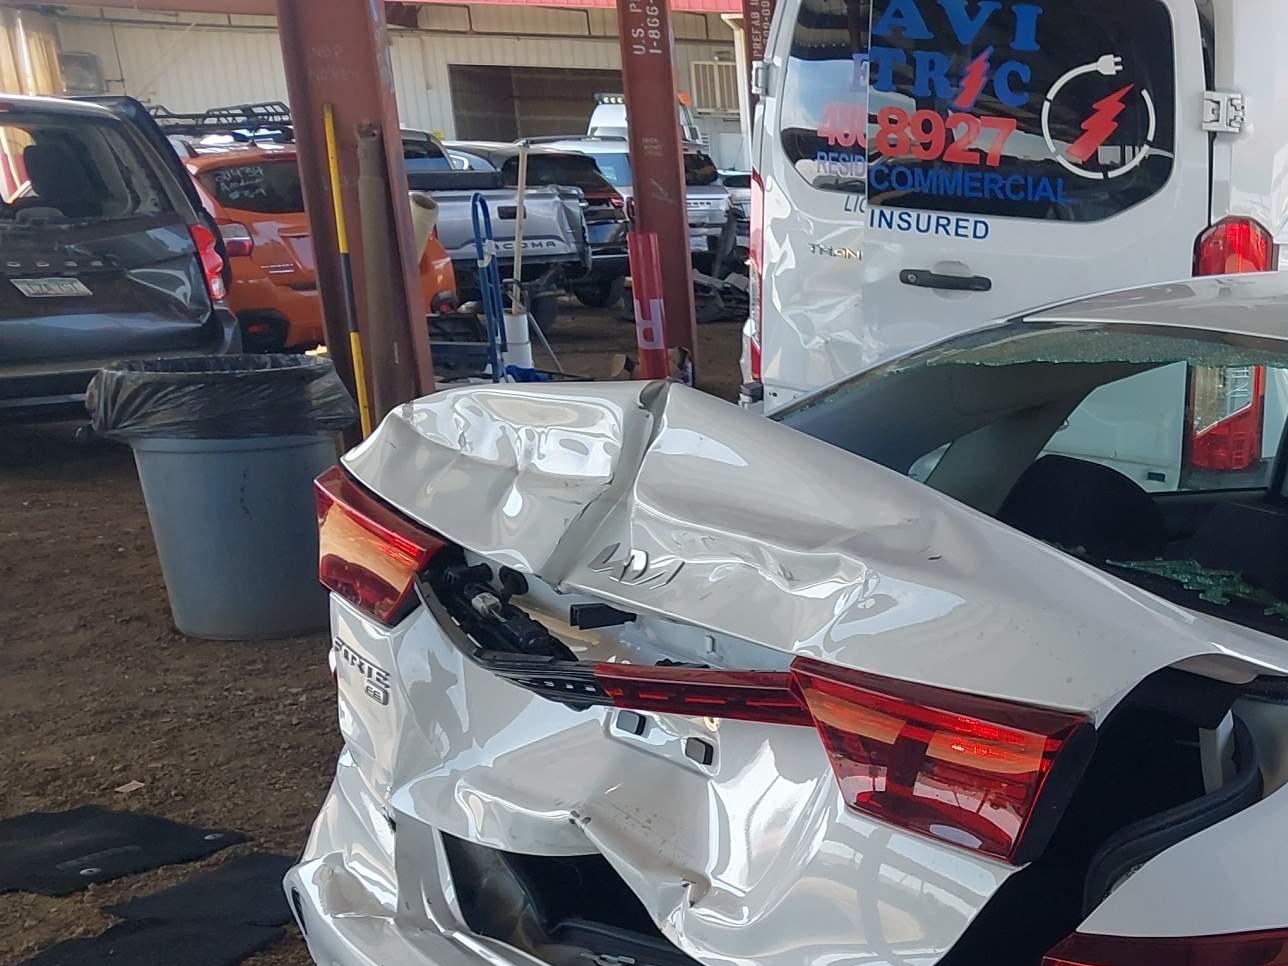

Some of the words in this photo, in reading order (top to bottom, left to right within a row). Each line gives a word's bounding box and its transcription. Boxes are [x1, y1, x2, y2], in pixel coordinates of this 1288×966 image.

[632, 24, 646, 54] U.S.
[750, 11, 763, 57] PREFAB
[875, 106, 1017, 167] 8927
[869, 163, 1076, 206] COMMERCIAL
[869, 209, 990, 240] INSURED
